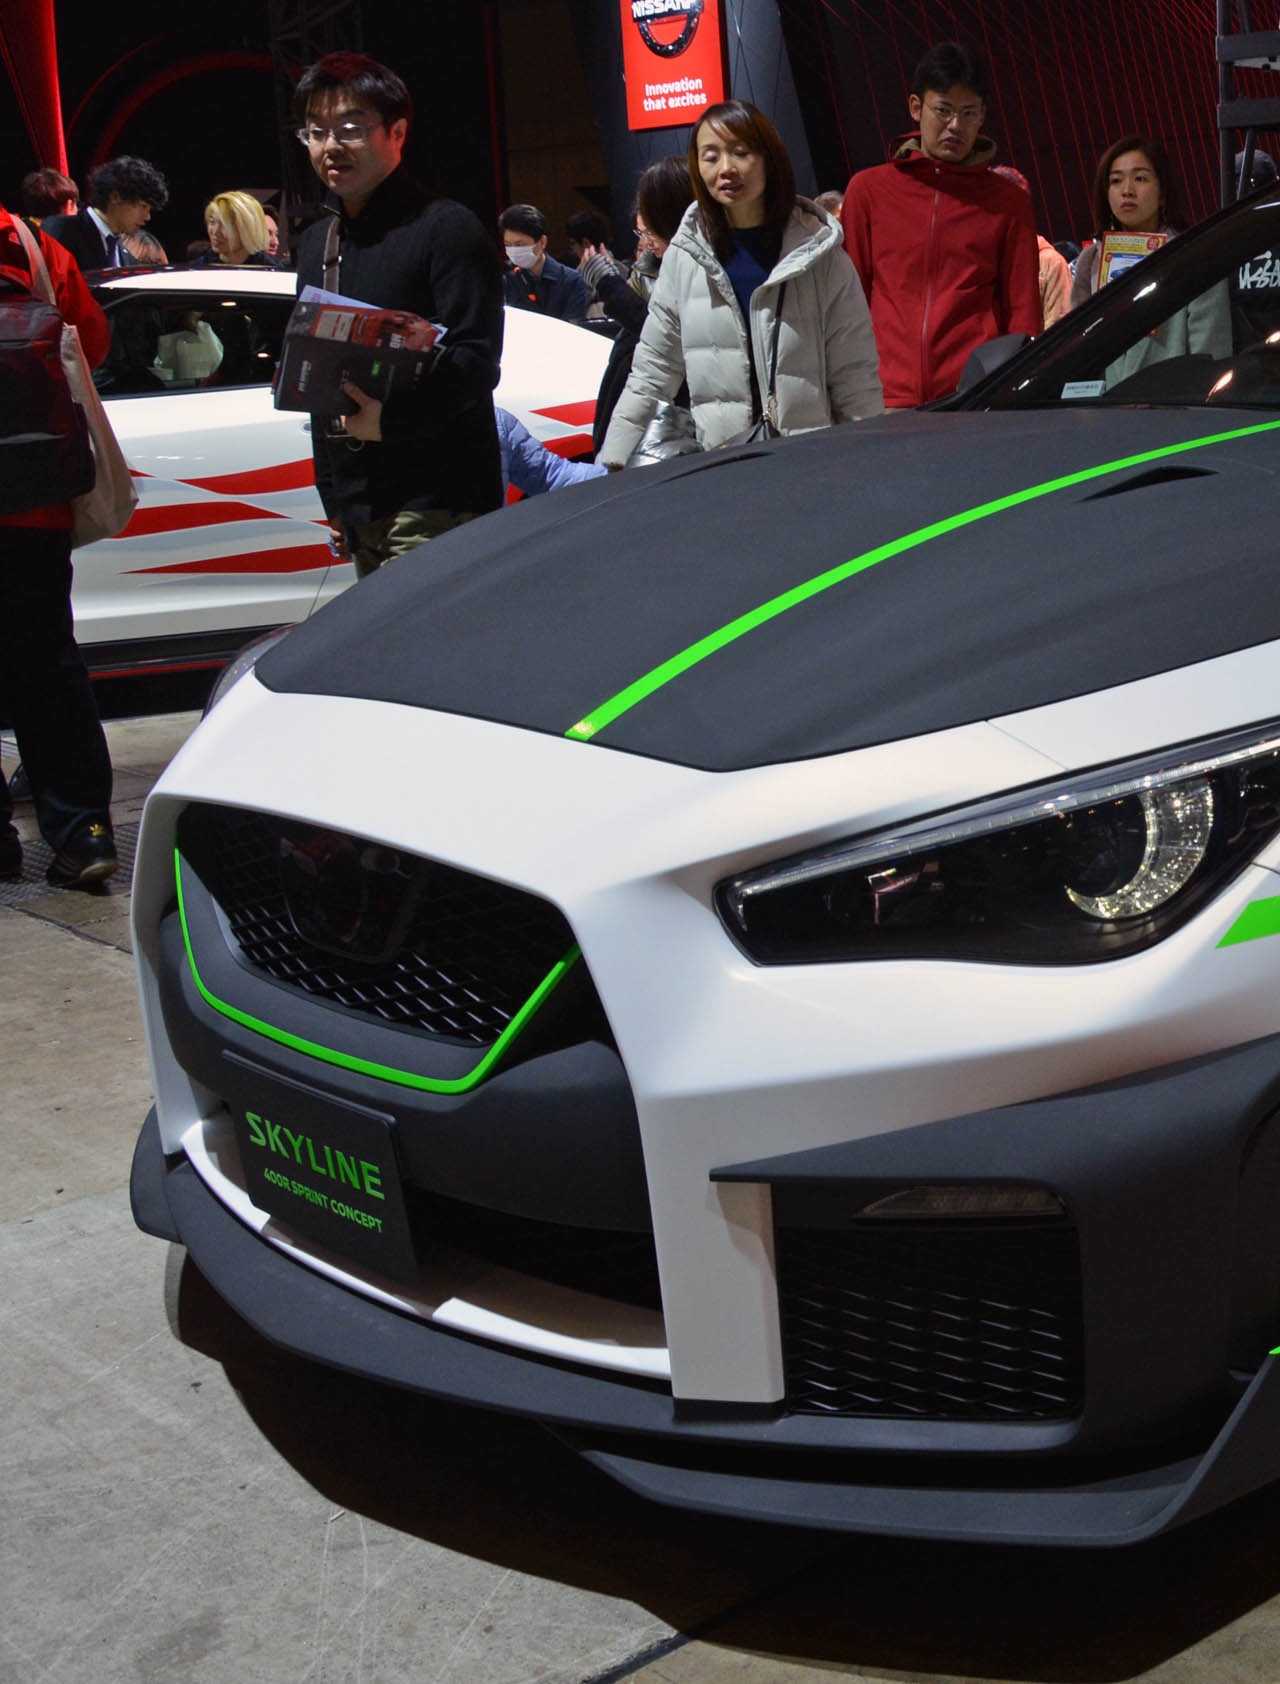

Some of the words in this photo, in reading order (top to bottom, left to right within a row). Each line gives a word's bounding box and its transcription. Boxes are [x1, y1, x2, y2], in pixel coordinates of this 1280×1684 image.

[632, 0, 695, 18] NISSAN
[645, 77, 703, 97] Innovation
[643, 97, 667, 112] that
[668, 92, 707, 109] excites
[245, 1111, 386, 1201] SKYLINE
[264, 1168, 291, 1192] 400R
[291, 1180, 329, 1209] SPRINT
[330, 1199, 383, 1233] CONCEPT
